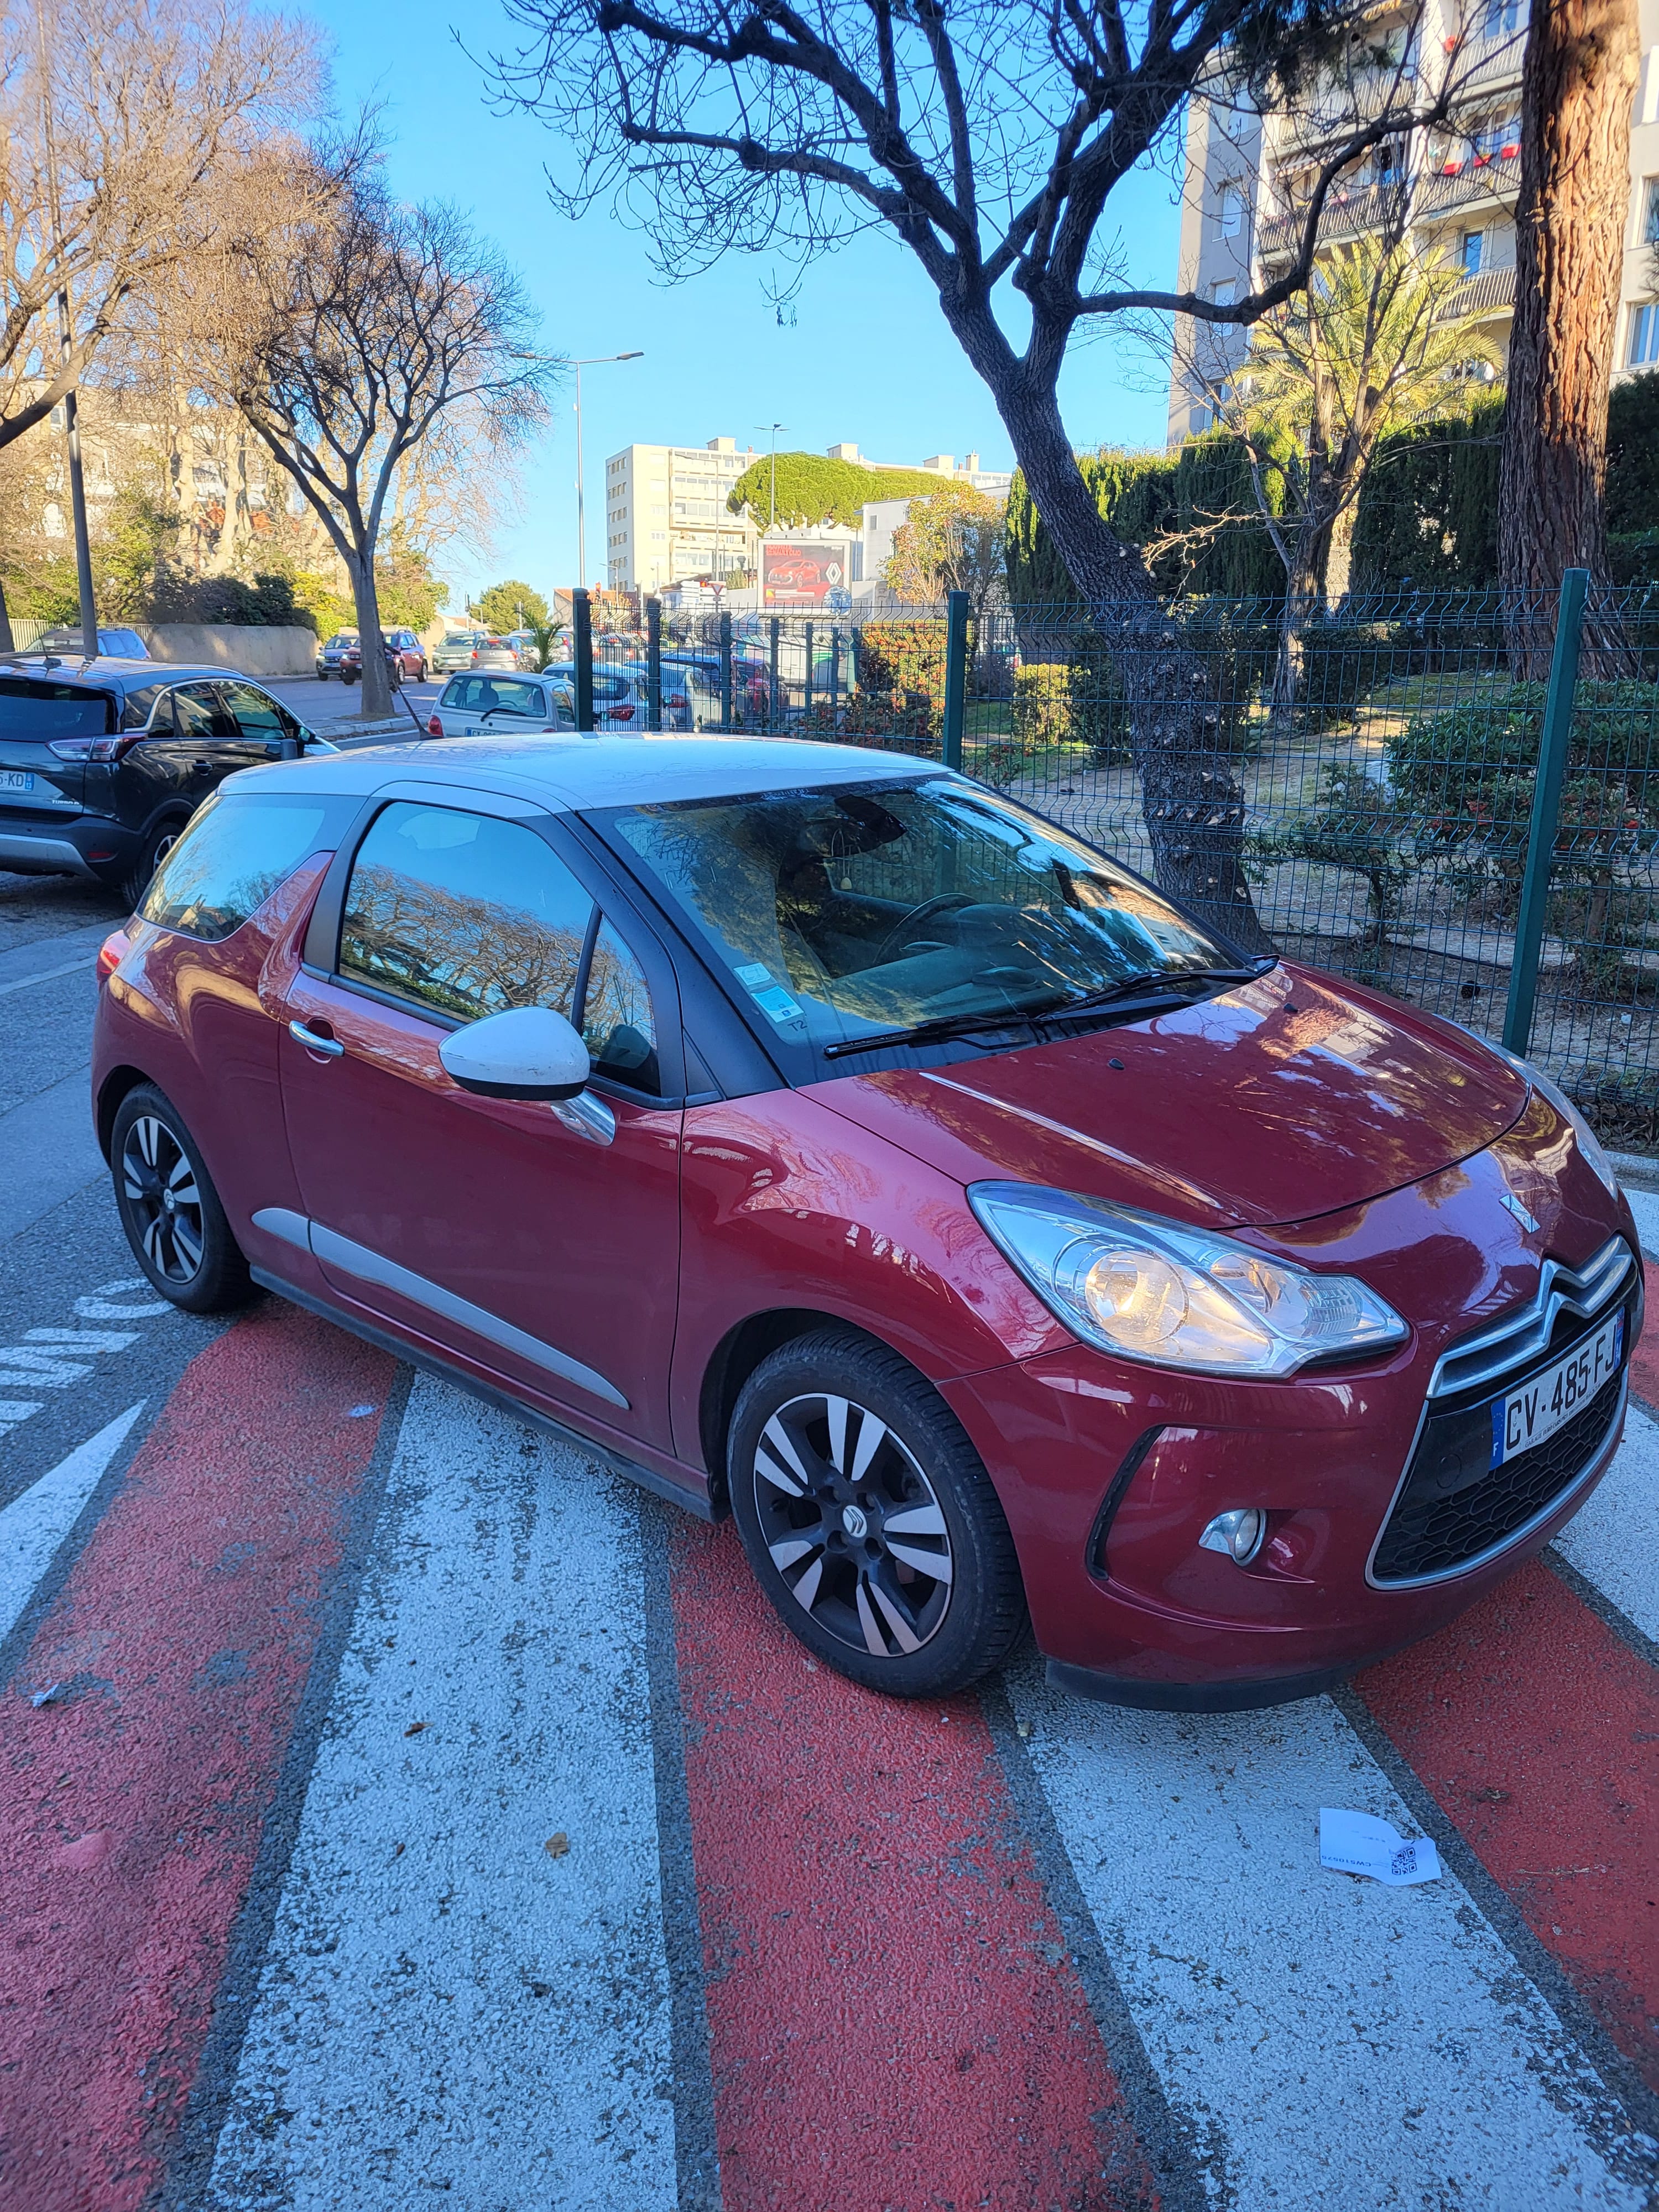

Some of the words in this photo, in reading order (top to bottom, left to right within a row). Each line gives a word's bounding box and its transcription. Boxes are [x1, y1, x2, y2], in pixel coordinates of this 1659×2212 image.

[787, 1020, 807, 1031] T2
[1525, 1433, 1542, 1447] GARAGE
[1493, 1442, 1499, 1457] F
